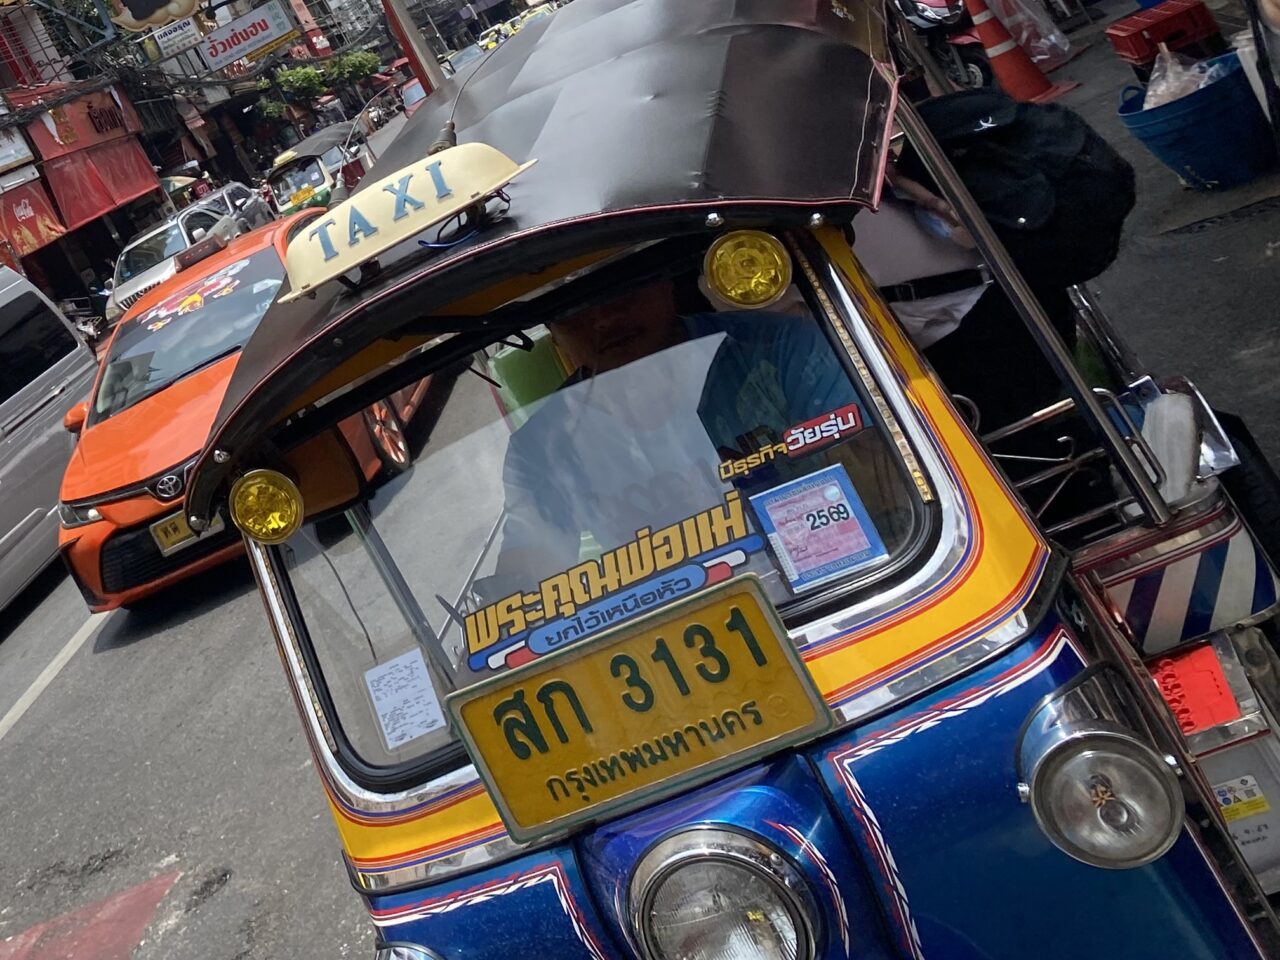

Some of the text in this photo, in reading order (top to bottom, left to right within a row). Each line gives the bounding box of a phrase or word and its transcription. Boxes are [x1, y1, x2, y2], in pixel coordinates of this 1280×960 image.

[309, 160, 454, 263] TAXI
[804, 502, 850, 532] 2569
[465, 489, 749, 654] พระคุณพ่อแม่
[543, 576, 692, 647] ยกไว้เหนือหัว
[492, 672, 593, 762] สก
[610, 606, 770, 715] 3131
[547, 697, 764, 807] กรุงเทพมหานคร
